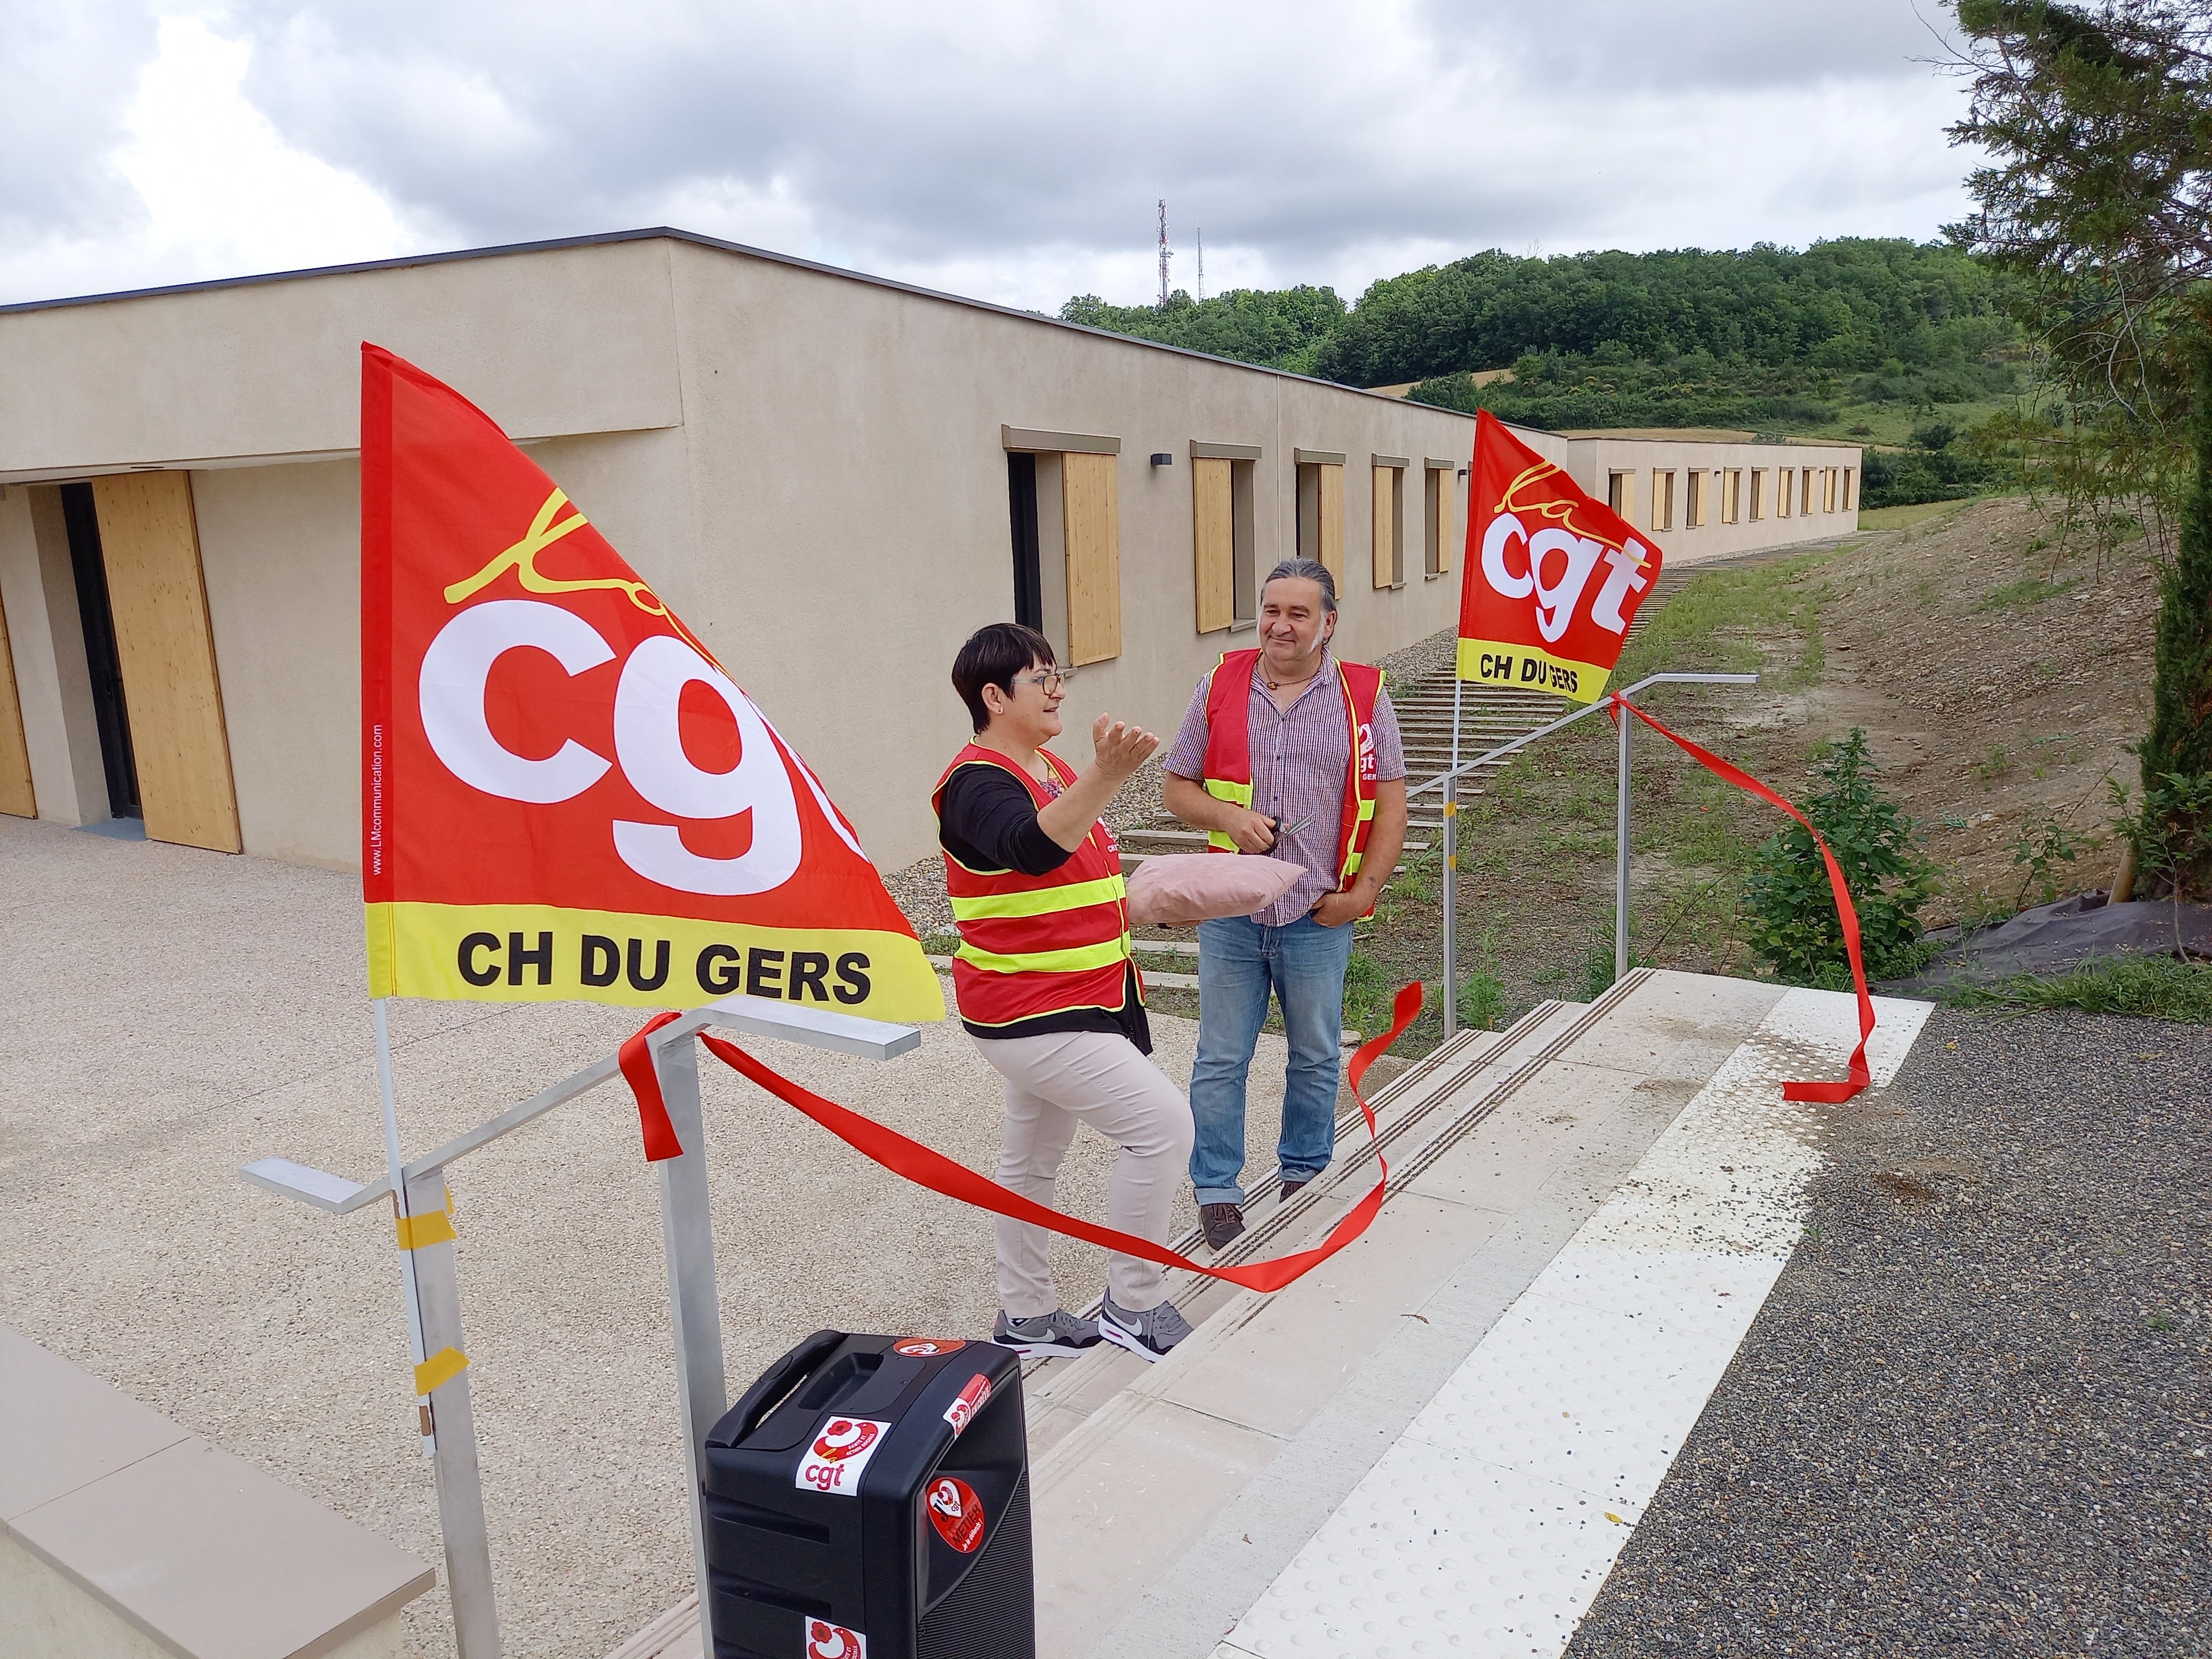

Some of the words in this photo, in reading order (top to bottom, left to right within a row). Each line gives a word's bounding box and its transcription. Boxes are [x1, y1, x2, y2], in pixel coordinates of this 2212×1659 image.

[1481, 512, 1648, 643] cgt
[1480, 654, 1514, 680] CH
[1521, 658, 1547, 685] DU
[1550, 666, 1578, 693] GERS
[1360, 754, 1375, 773] gt
[371, 724, 383, 876] www.LMcommunication.com
[458, 931, 553, 986] CH
[581, 933, 670, 992] DU
[696, 944, 872, 1004] GERS
[805, 1464, 845, 1491] cgt
